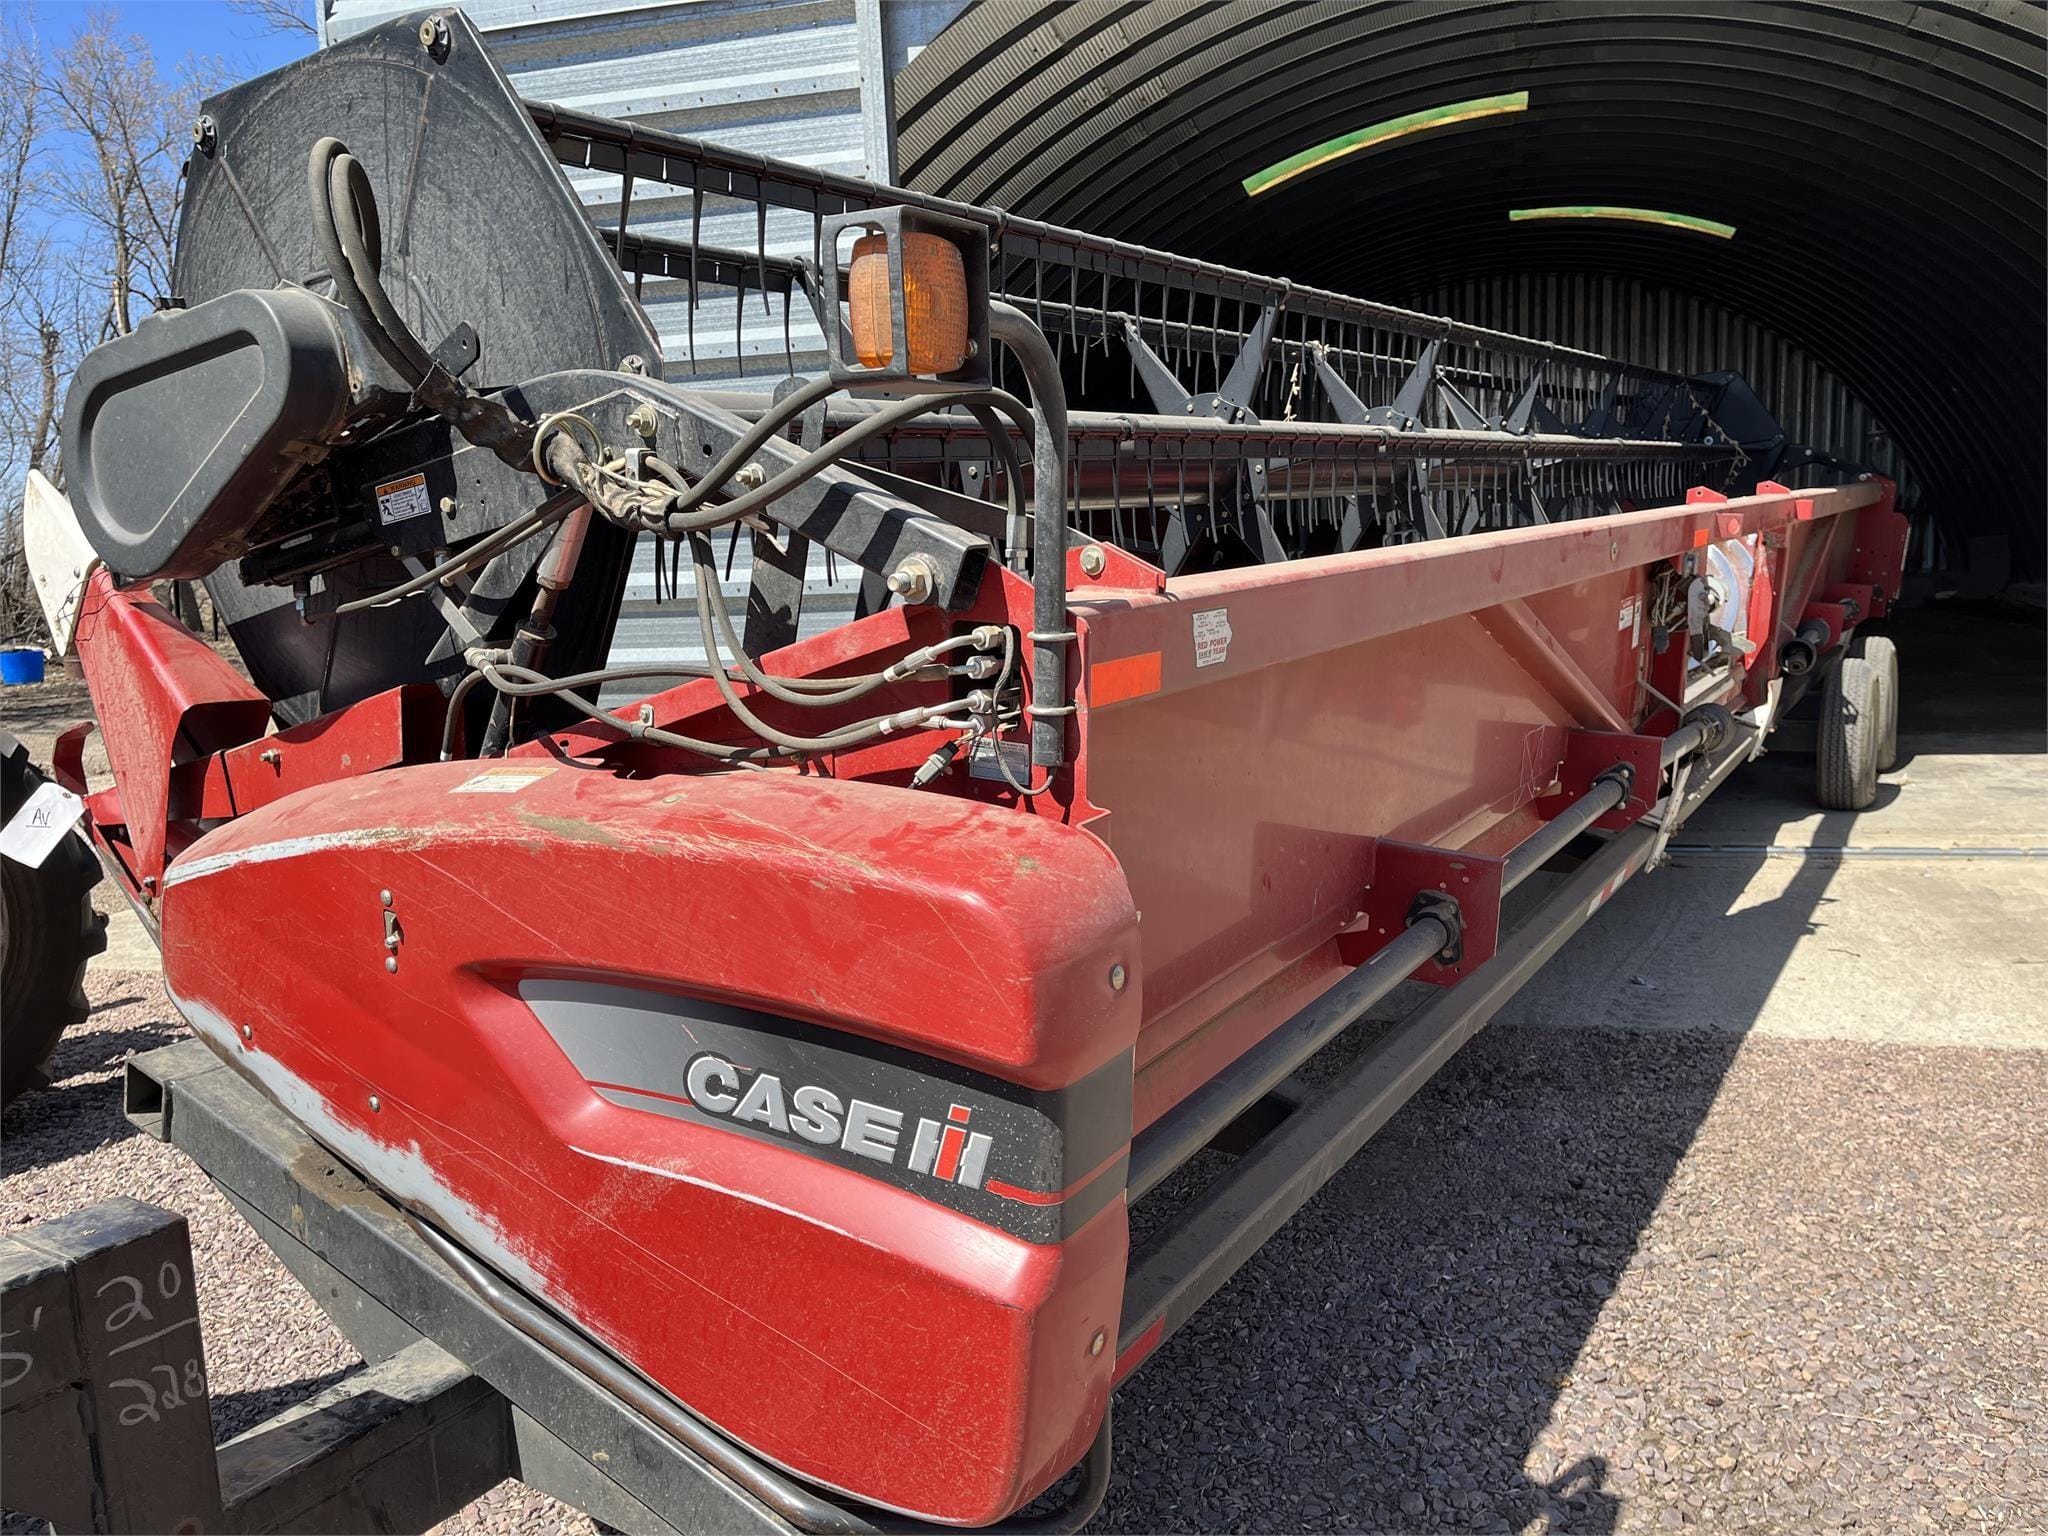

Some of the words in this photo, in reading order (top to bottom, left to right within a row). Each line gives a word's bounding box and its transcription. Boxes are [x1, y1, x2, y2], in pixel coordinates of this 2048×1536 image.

[1197, 641, 1208, 651] RED
[1209, 637, 1228, 648] POWER
[1212, 646, 1226, 655] TEAM
[687, 1056, 904, 1164] CASE
[96, 1260, 182, 1332] 20
[108, 1359, 207, 1427] 228
